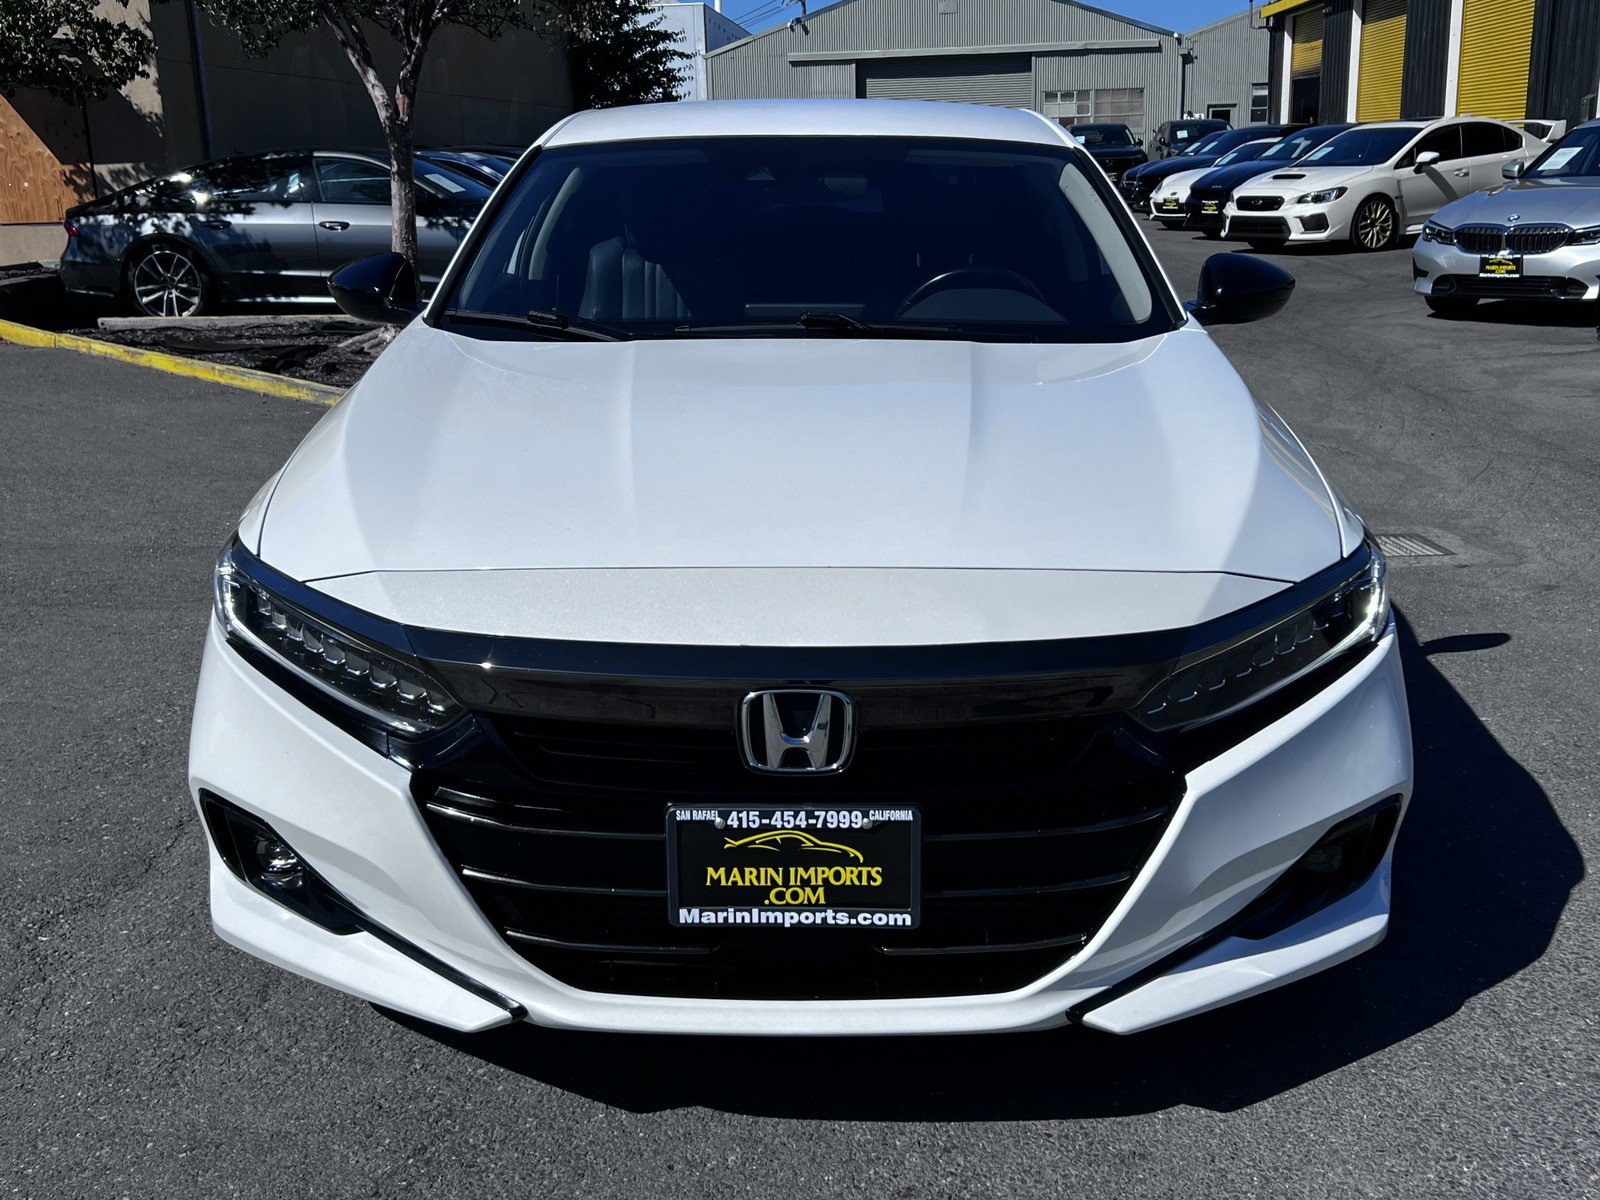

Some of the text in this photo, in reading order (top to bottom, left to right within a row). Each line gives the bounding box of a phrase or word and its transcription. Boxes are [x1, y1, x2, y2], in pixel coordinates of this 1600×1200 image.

[676, 810, 719, 821] SAN RAFAEL
[727, 811, 863, 829] 415-454-7999
[869, 810, 913, 821] CALIFORNIA
[706, 866, 882, 886] MARIN IMPORTS
[764, 887, 826, 905] .COM
[679, 908, 912, 927] MarinImports.com
